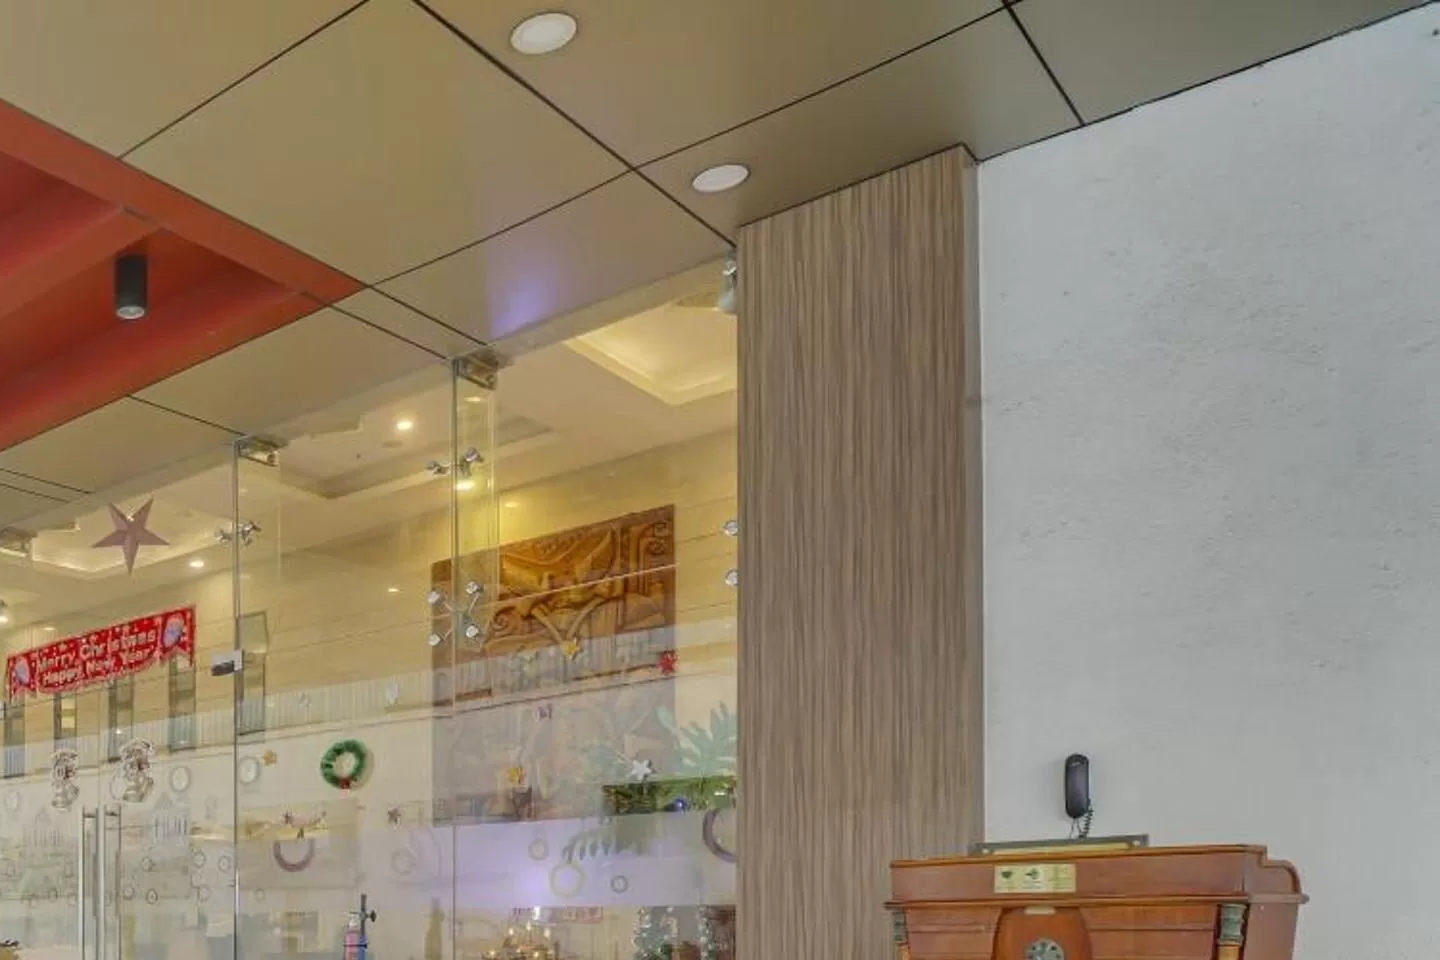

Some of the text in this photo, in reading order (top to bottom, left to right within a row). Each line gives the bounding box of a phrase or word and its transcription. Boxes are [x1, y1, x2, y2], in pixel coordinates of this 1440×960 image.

[37, 629, 157, 672] Merry Christmas
[42, 665, 83, 686] Happy
[86, 656, 115, 674] New
